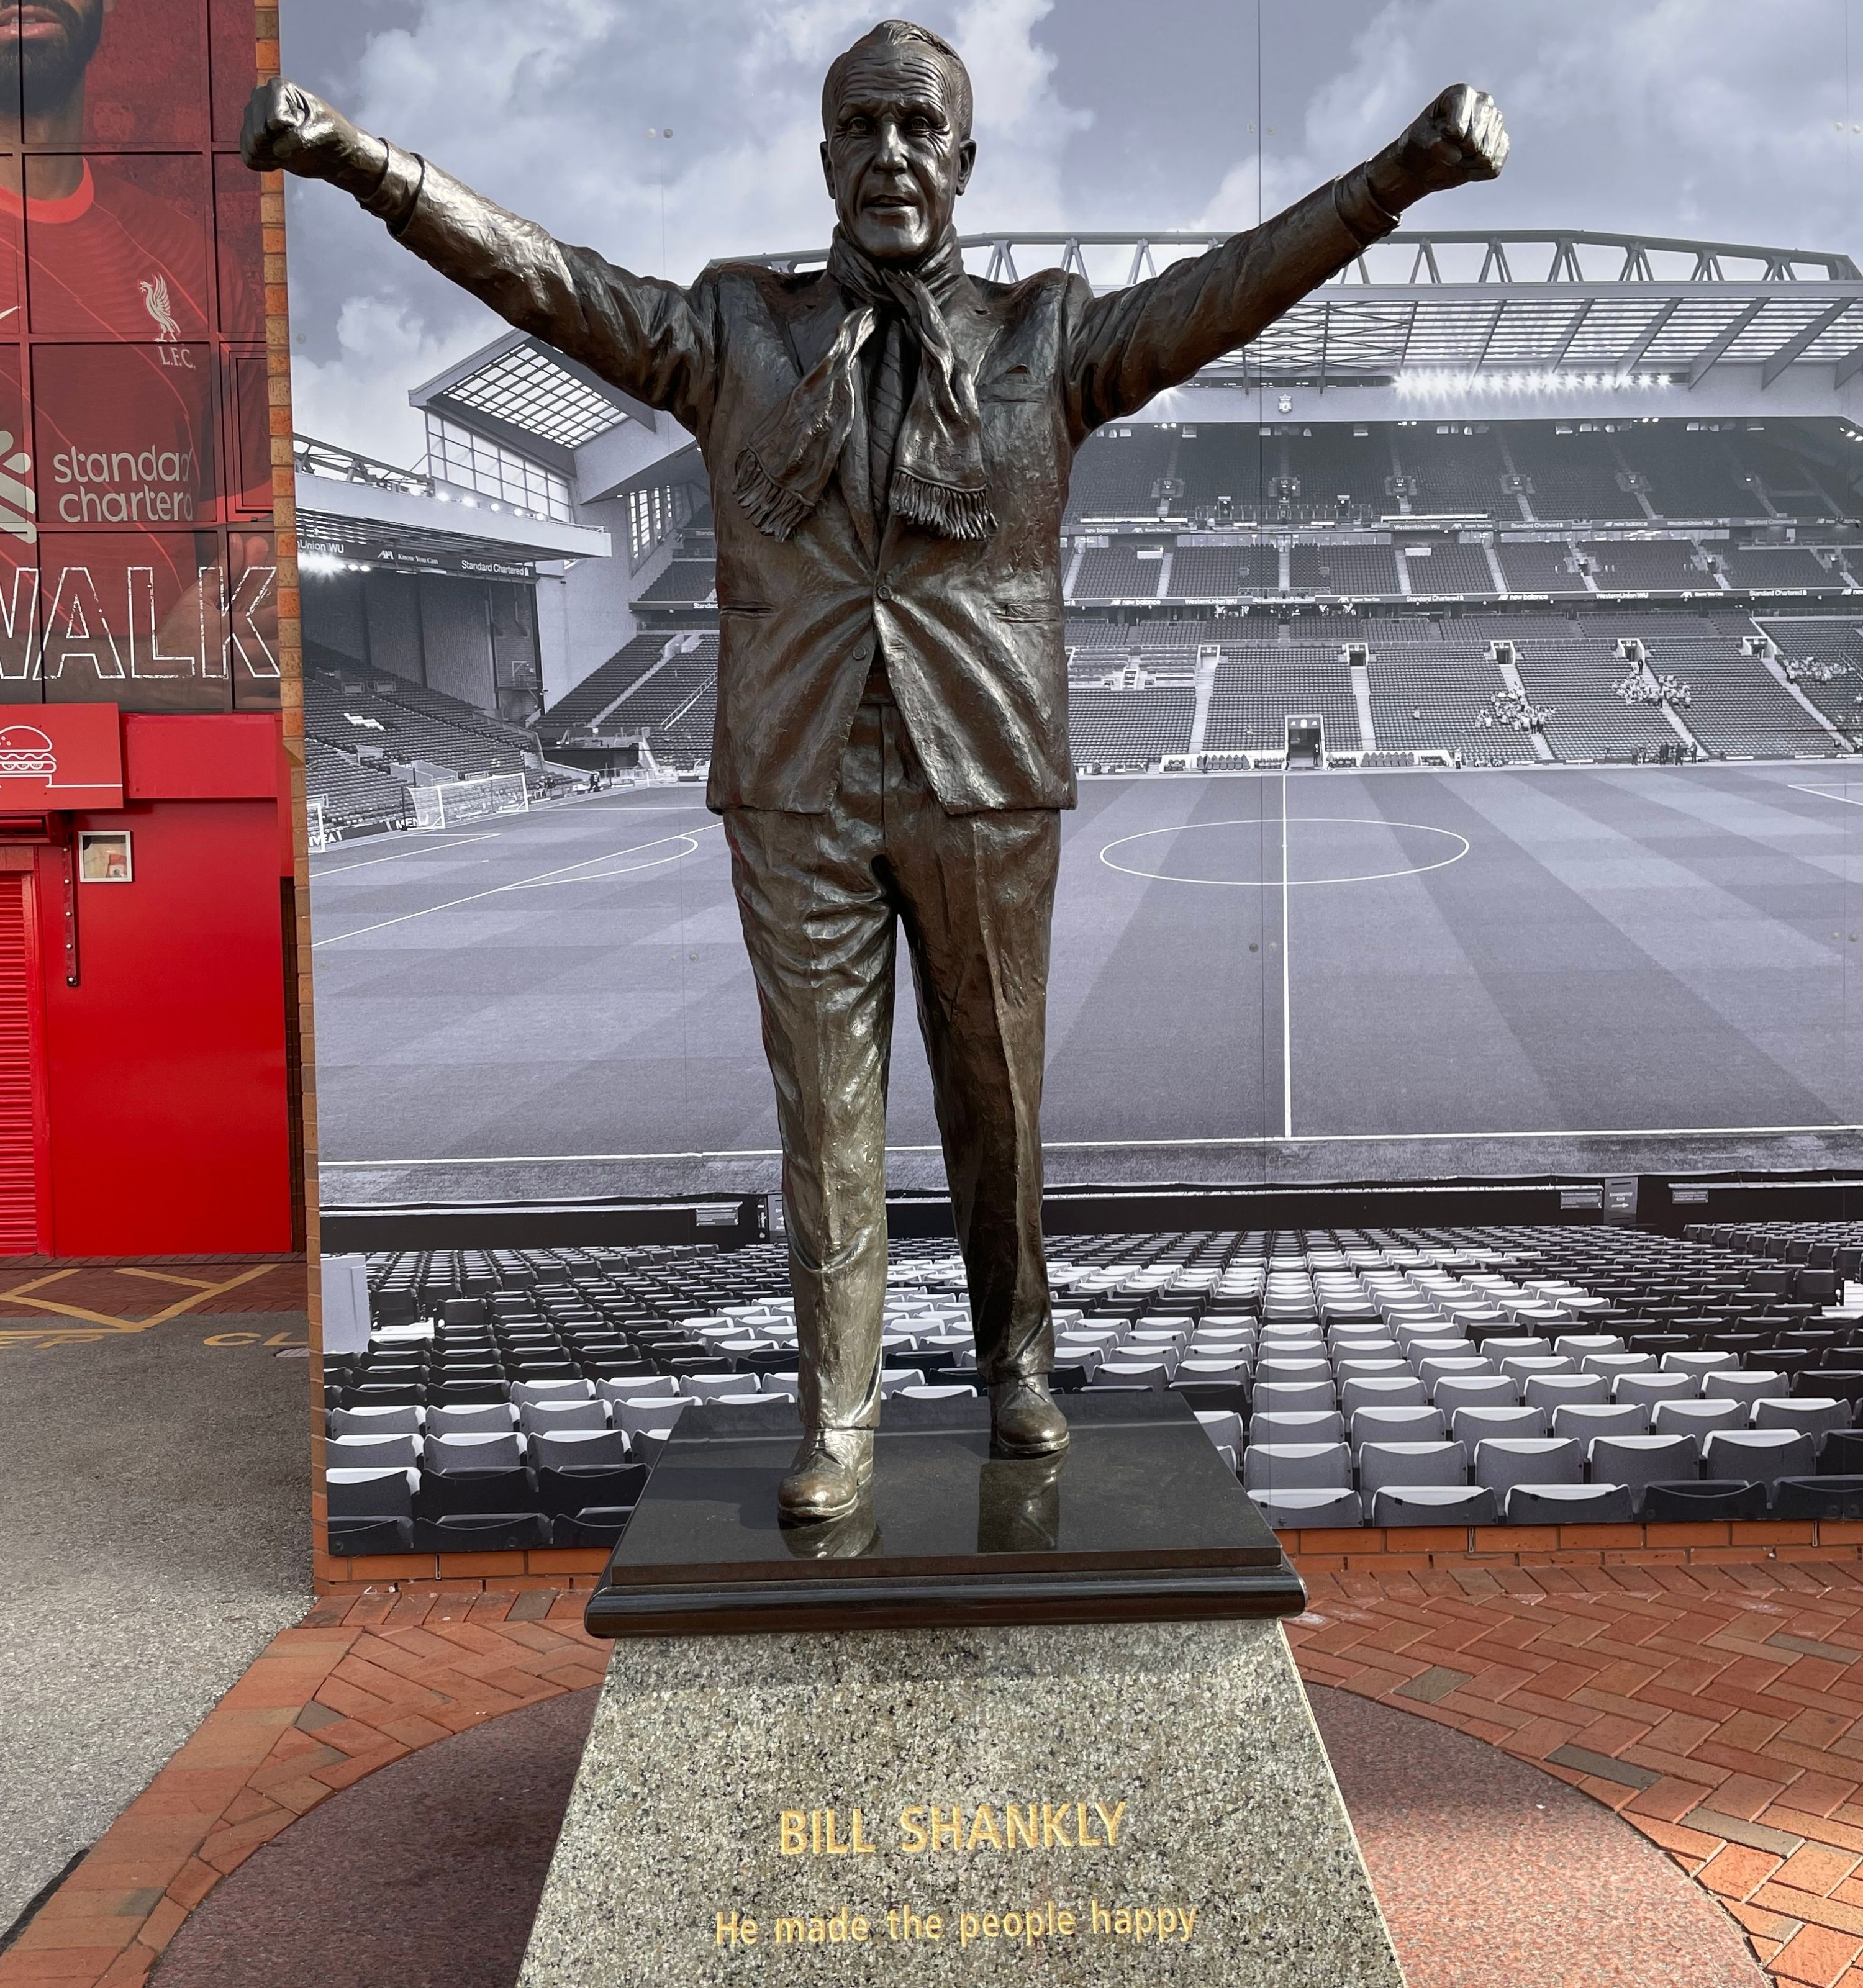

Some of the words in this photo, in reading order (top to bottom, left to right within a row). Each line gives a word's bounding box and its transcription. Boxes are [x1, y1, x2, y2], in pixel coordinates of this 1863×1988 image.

[158, 346, 197, 370] L.F.C.
[328, 542, 345, 554] WU
[378, 550, 394, 560] AXA
[461, 559, 492, 572] Standard
[493, 563, 524, 576] Chartered
[779, 1807, 876, 1855] BILL
[899, 1801, 1128, 1853] SHANKLY
[716, 1910, 758, 1945] He
[775, 1907, 871, 1944] made
[888, 1904, 944, 1940] the
[960, 1901, 1078, 1947] people
[1091, 1899, 1199, 1944] happy
